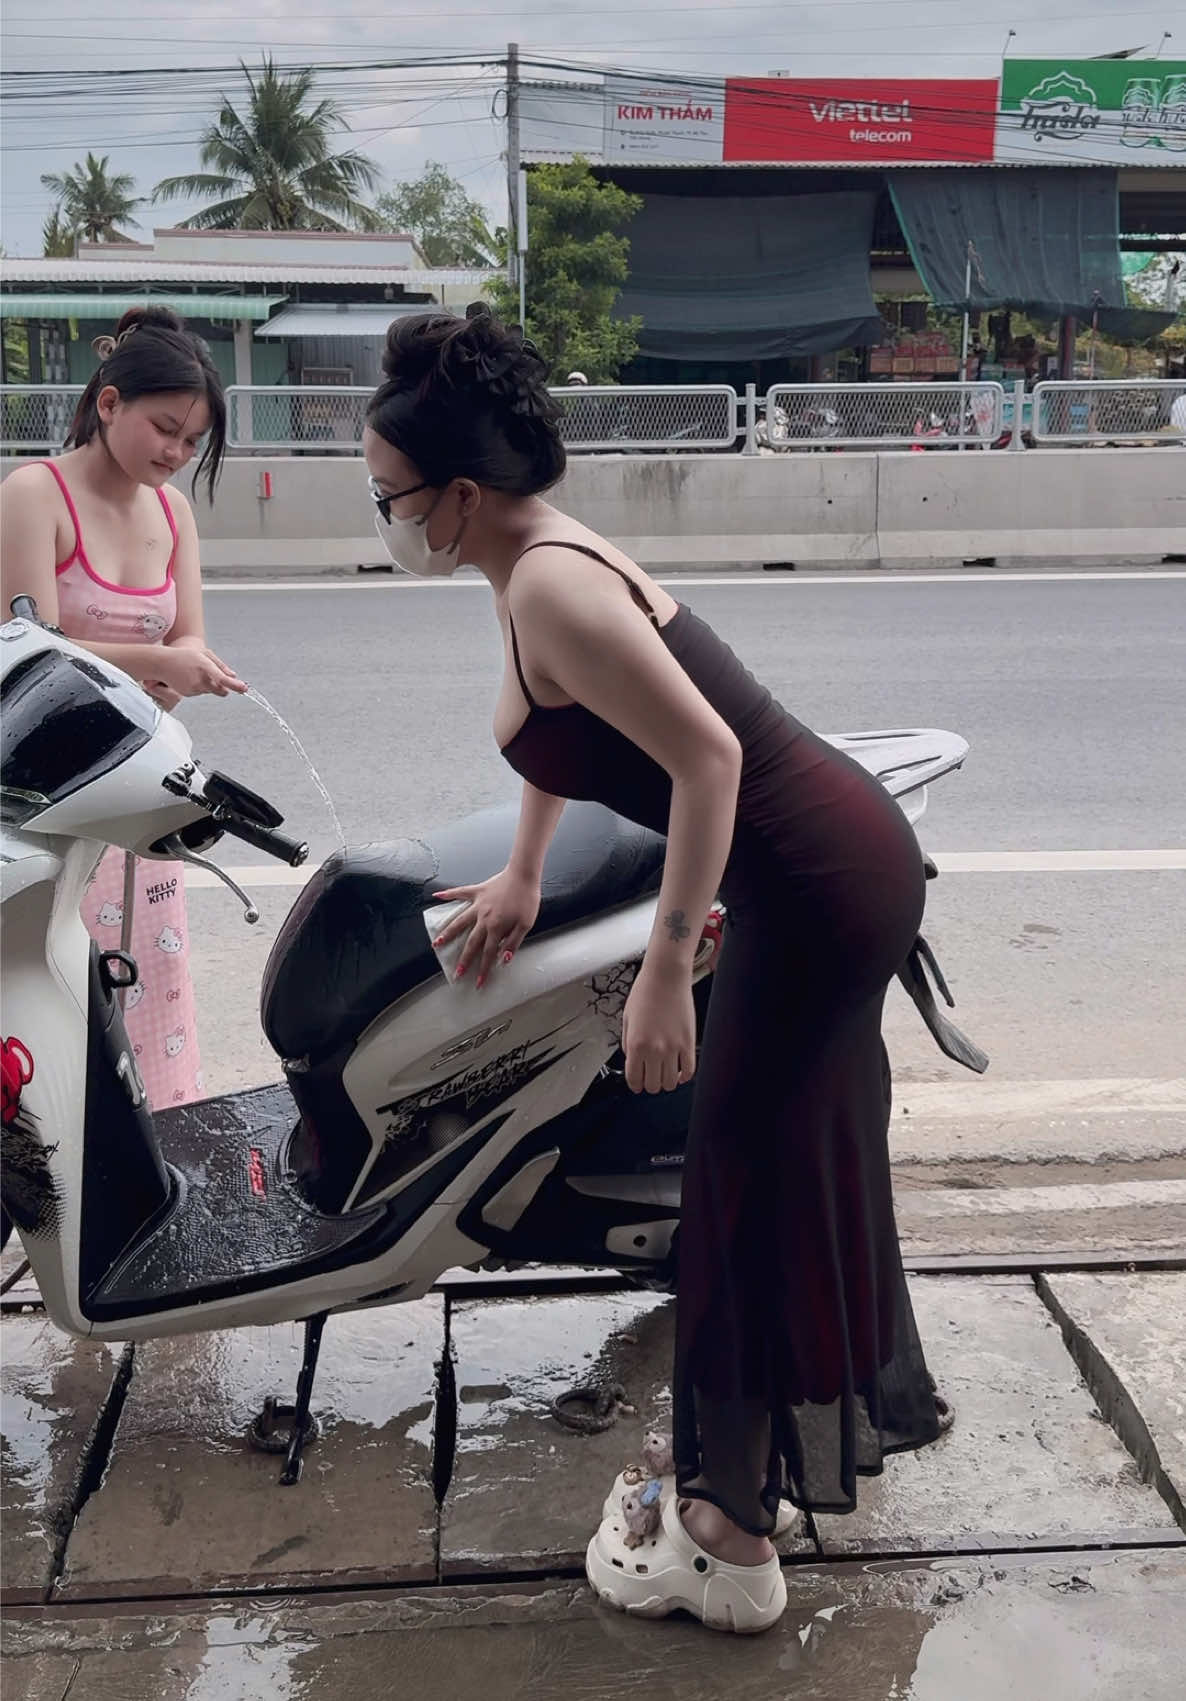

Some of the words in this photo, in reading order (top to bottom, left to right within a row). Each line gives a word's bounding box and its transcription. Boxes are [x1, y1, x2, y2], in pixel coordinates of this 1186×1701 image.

[617, 104, 653, 120] KIM
[808, 99, 913, 122] viettel
[849, 129, 912, 142] telecom
[146, 878, 177, 896] HELLO
[148, 887, 176, 904] KITTY
